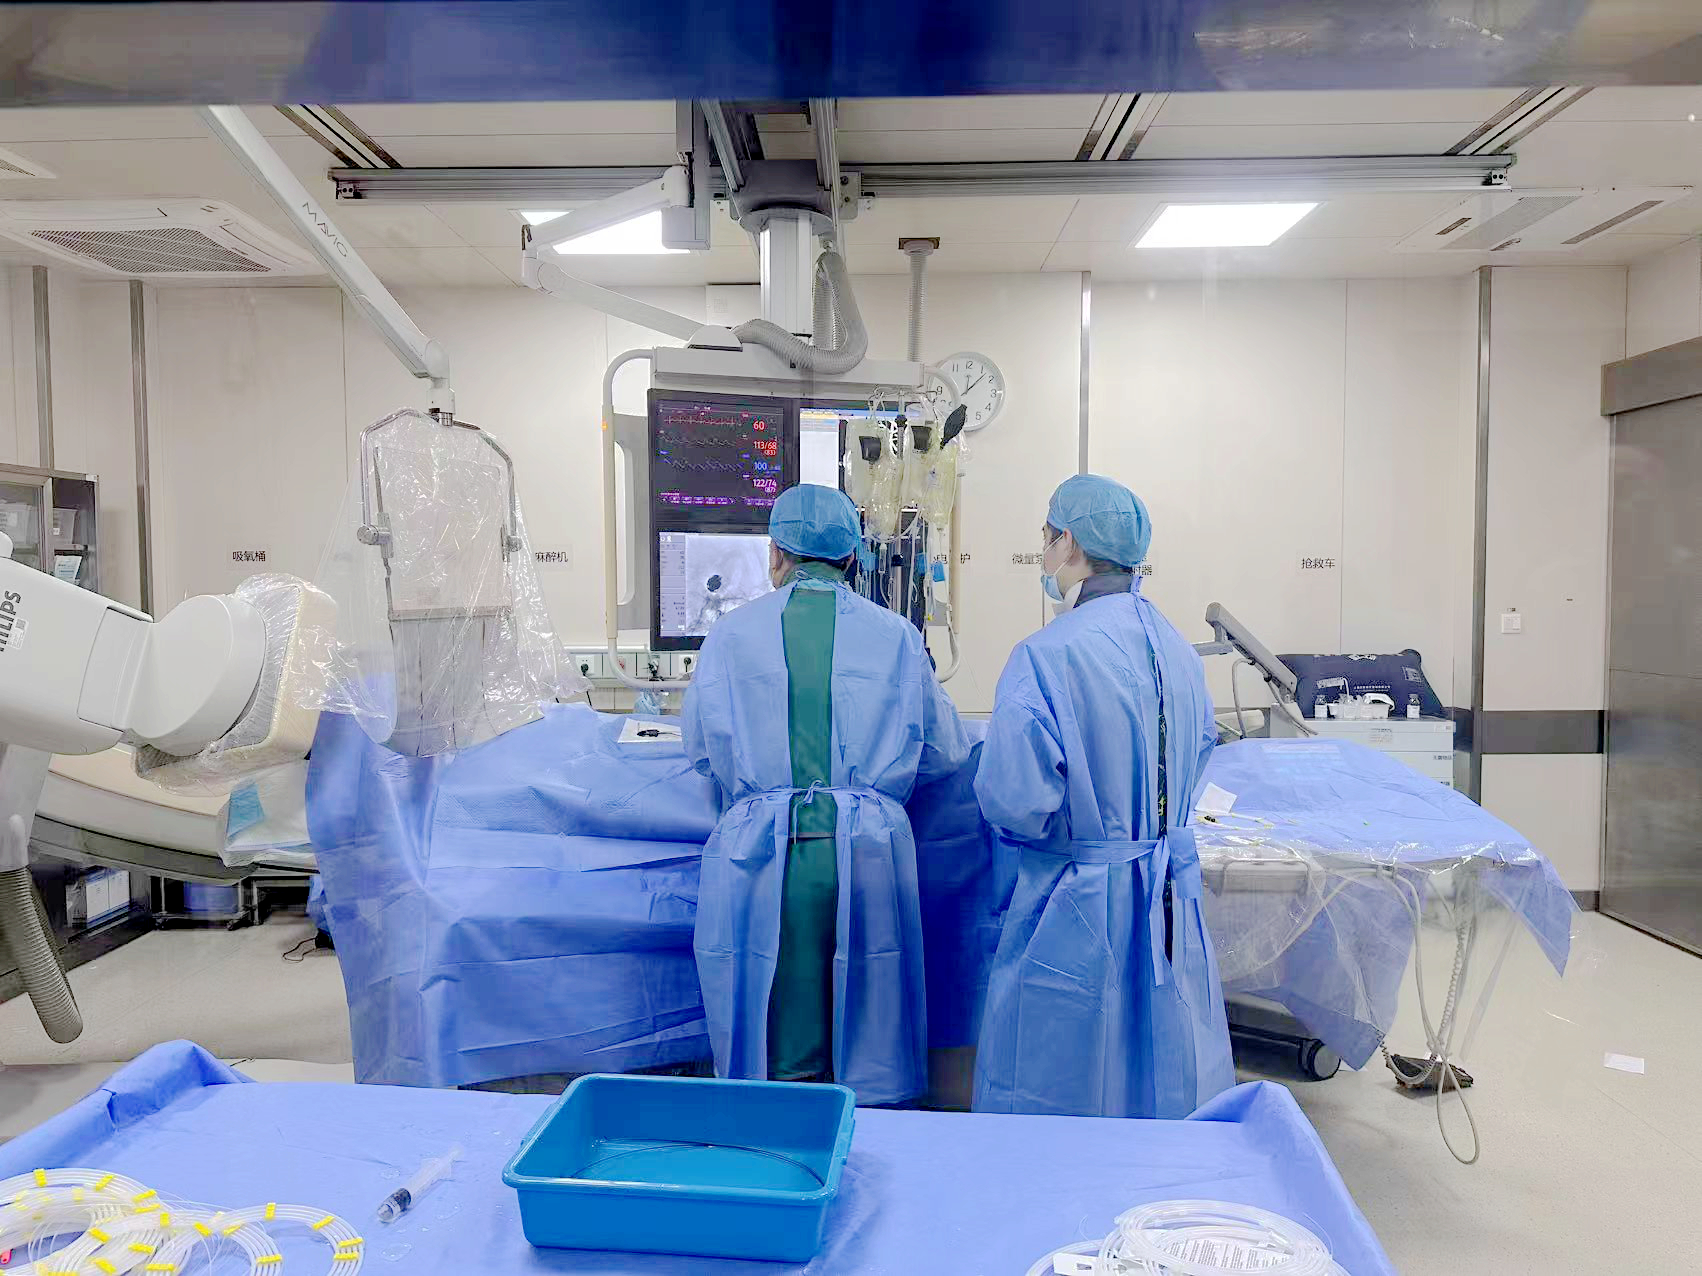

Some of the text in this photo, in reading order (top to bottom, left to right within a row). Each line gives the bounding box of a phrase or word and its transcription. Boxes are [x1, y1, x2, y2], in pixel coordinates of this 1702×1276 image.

[952, 363, 959, 372] 11
[965, 361, 974, 369] 12
[988, 375, 995, 384] 2
[936, 386, 943, 395] 9
[990, 389, 997, 398] 3
[985, 403, 992, 411] 4
[975, 412, 982, 420] 5
[753, 420, 765, 430] 60
[753, 441, 777, 449] 113/68
[754, 462, 767, 470] 100
[753, 479, 777, 487] 122/74
[232, 550, 266, 561] 吸氧桶
[535, 551, 569, 562] 麻醉机
[1301, 557, 1336, 569] 抢救车
